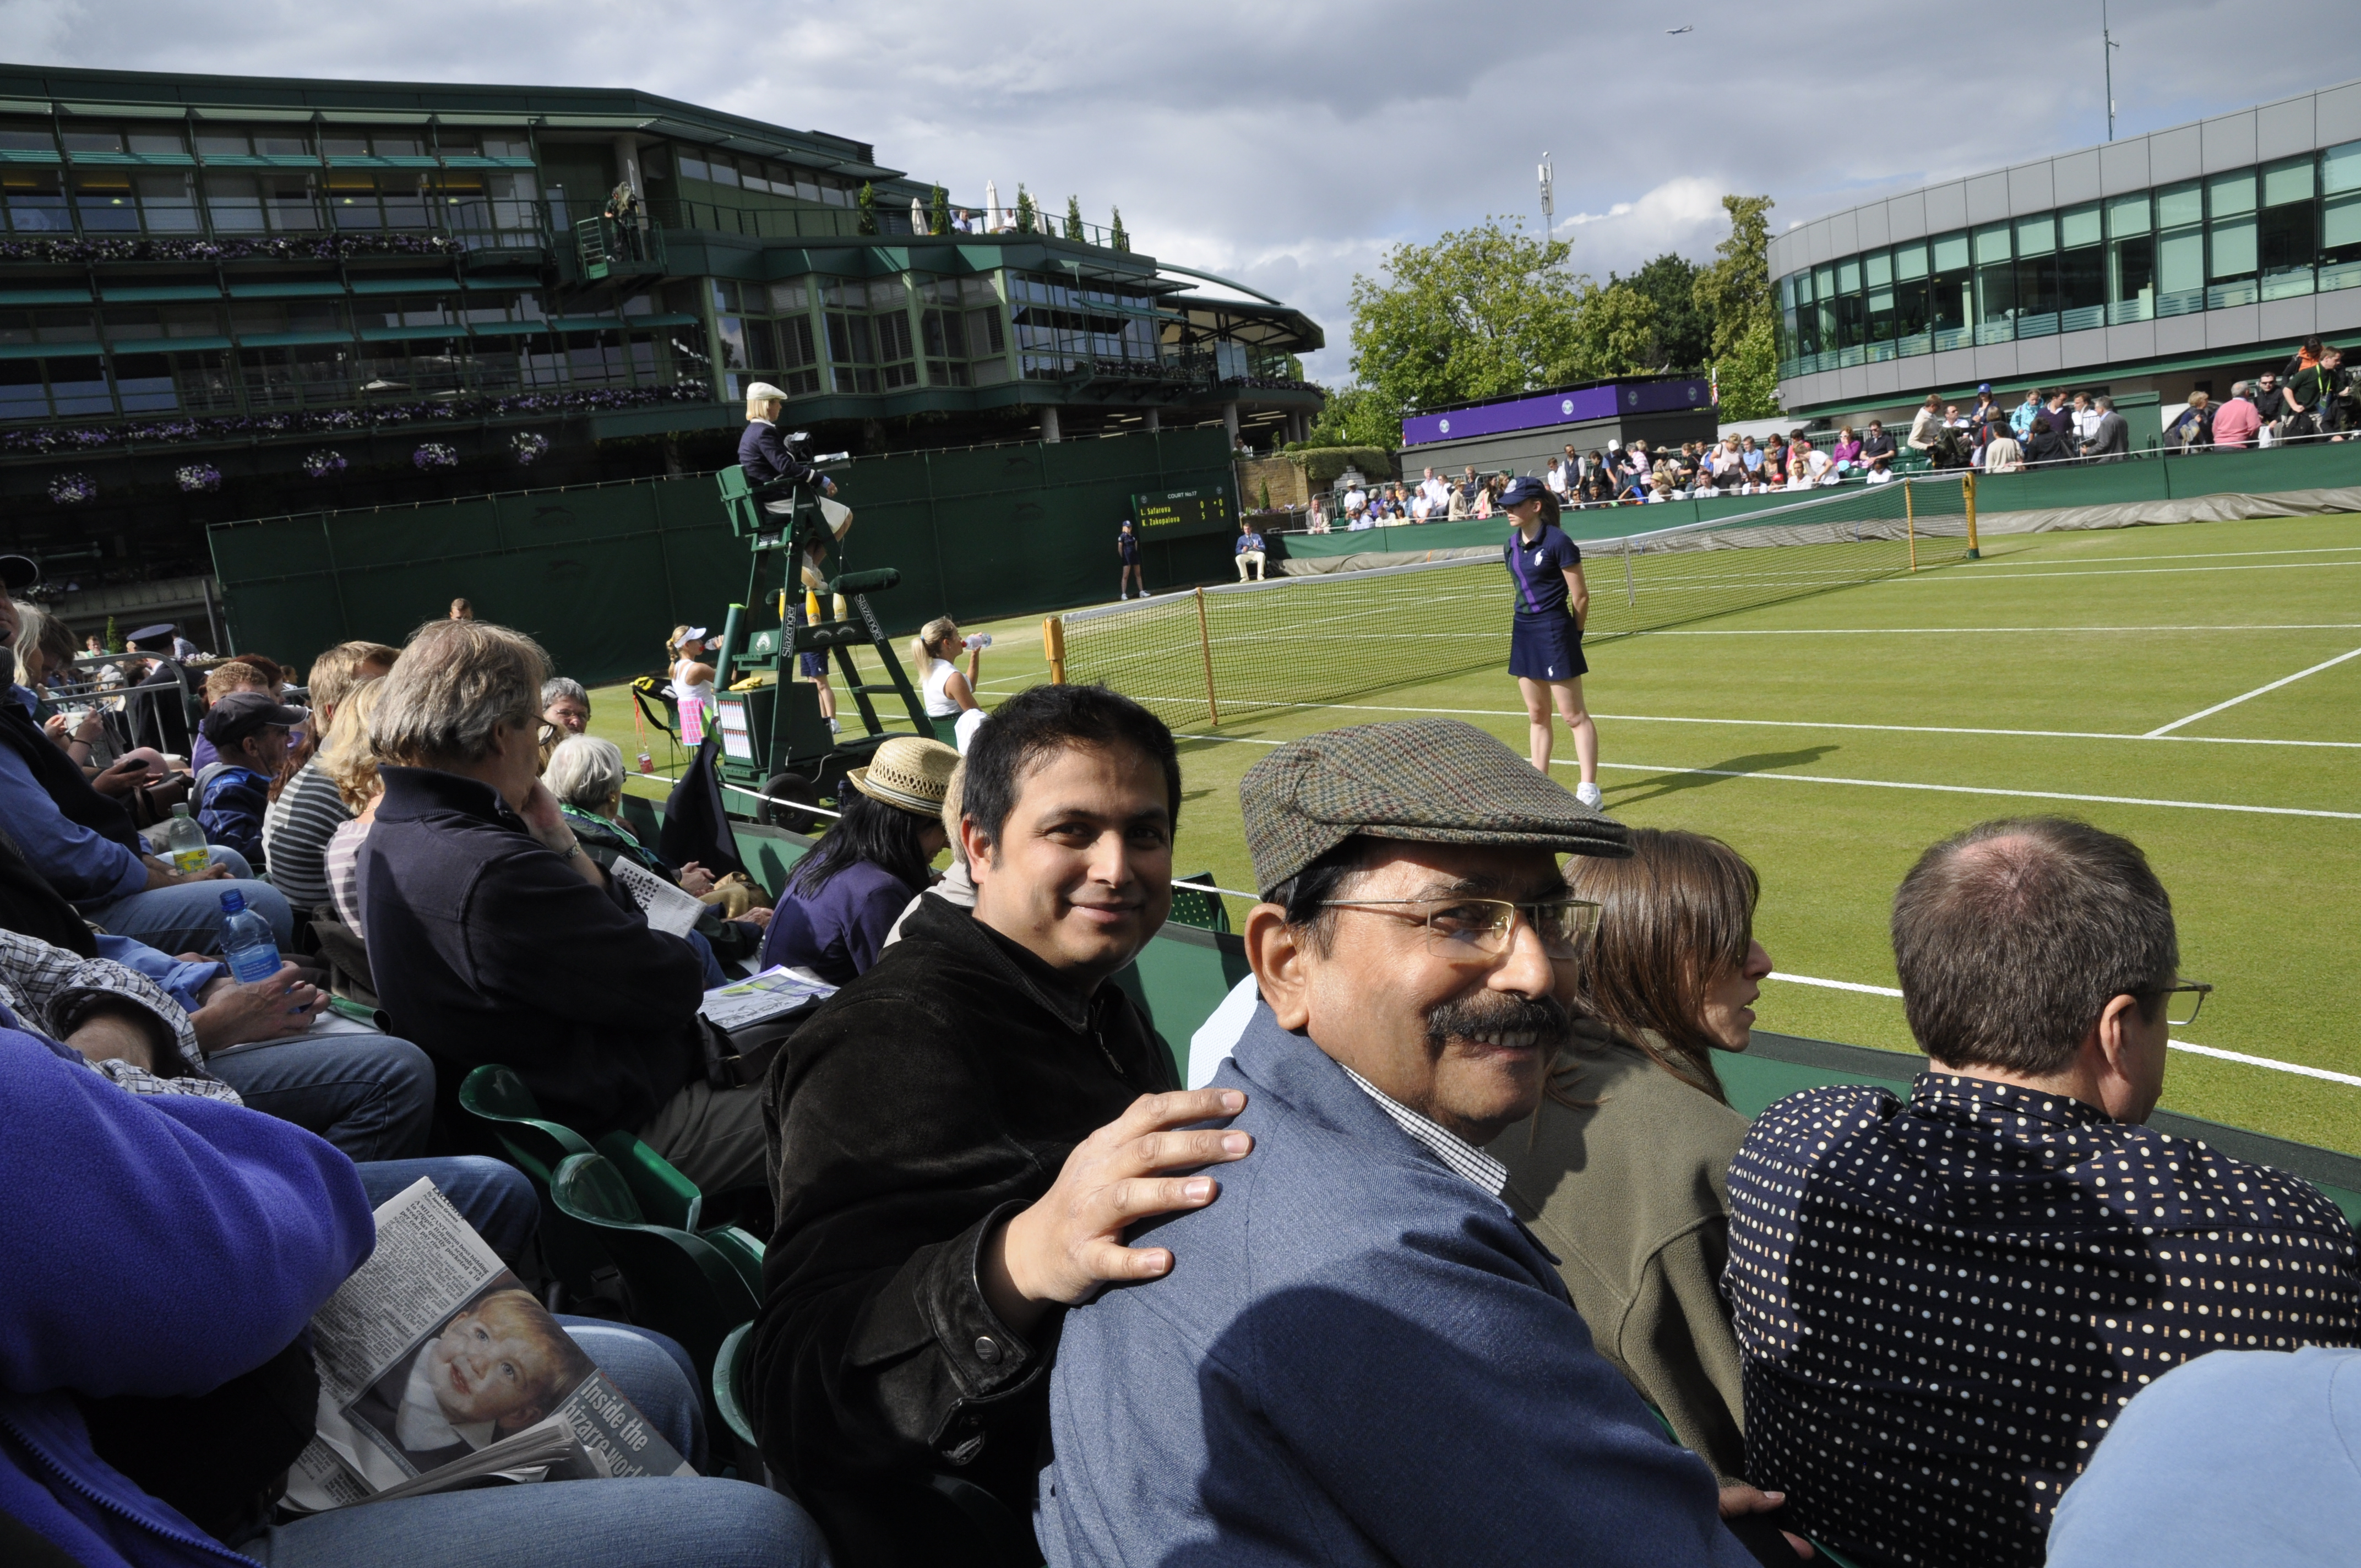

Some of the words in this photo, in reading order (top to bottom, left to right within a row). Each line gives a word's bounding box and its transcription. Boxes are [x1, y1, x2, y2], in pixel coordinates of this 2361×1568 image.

[1147, 507, 1171, 515] Safarova
[1200, 500, 1204, 509] 0
[1218, 498, 1223, 507] 0
[1149, 516, 1180, 525] Zakopalova
[782, 606, 796, 658] Slazenger
[856, 593, 884, 641] Slazenger
[399, 1211, 410, 1221] per
[409, 1219, 422, 1231] cent
[420, 1231, 431, 1241] pay
[429, 1239, 443, 1251] rise.
[404, 1206, 420, 1221] week
[418, 1219, 429, 1231] has
[427, 1229, 447, 1248] quietly
[444, 1246, 470, 1271] pocketed
[472, 1273, 481, 1282] 10
[415, 1208, 435, 1228] cripple
[433, 1226, 456, 1248] Britain's
[454, 1246, 474, 1266] schools
[472, 1265, 486, 1277] next
[418, 1204, 448, 1232] MILITANT
[444, 1229, 461, 1245] union
[458, 1243, 472, 1256] boss
[469, 1254, 489, 1274] bidding
[421, 1194, 437, 1209] Political
[434, 1207, 462, 1234] Correspondent
[431, 1196, 445, 1210] Jason
[443, 1207, 459, 1223] Groves
[381, 1224, 404, 1246] thousands
[407, 1251, 417, 1259] her
[416, 1259, 426, 1269] own
[425, 1268, 446, 1288] members
[444, 1287, 458, 1300] brace
[385, 1222, 394, 1230] the
[426, 1262, 436, 1271] rise
[434, 1271, 447, 1283] while
[445, 1282, 456, 1292] tens
[393, 1216, 410, 1233] National
[409, 1232, 422, 1245] Union
[444, 1267, 453, 1276] was
[451, 1274, 469, 1291] accused
[398, 1215, 418, 1235] Christine
[434, 1251, 444, 1260] the
[443, 1260, 458, 1274] leader
[463, 1280, 472, 1288] the
[450, 1280, 465, 1294] taking
[561, 1396, 610, 1451] bizarre
[607, 1447, 652, 1477] worl
[580, 1376, 627, 1430] Inside
[618, 1419, 649, 1451] the
